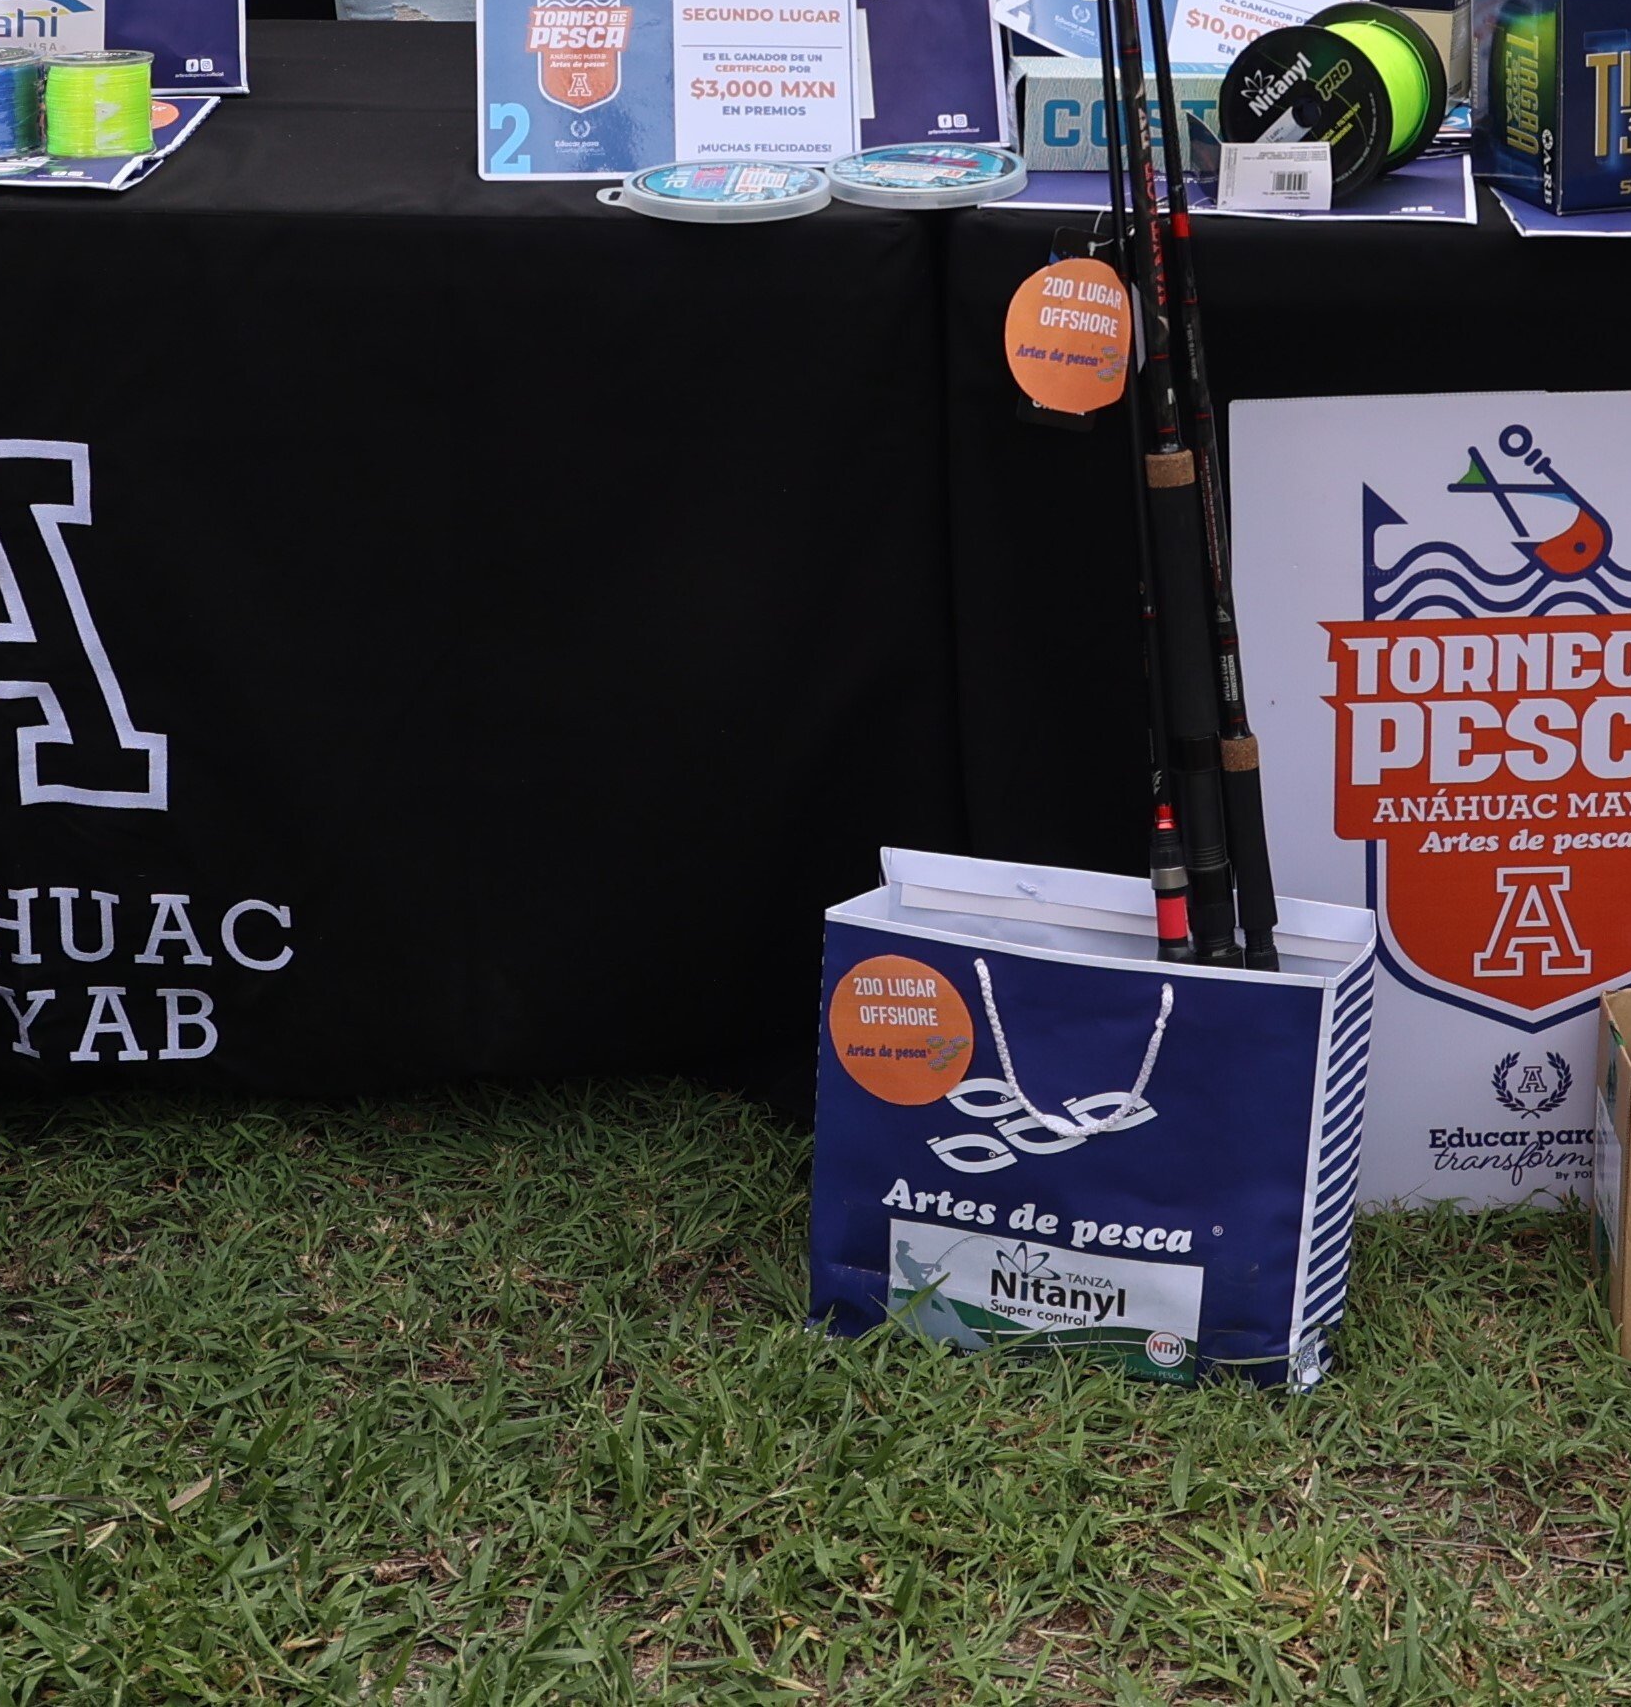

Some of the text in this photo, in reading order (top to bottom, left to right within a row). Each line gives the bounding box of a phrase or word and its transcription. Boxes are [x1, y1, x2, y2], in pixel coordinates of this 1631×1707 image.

[533, 11, 608, 26] TORNEO
[682, 8, 840, 23] SEGUNDO LUGAR
[1239, 0, 1293, 20] GANADOR
[530, 27, 626, 49] PESCA
[1217, 43, 1235, 55] EN
[703, 53, 716, 61] ES
[719, 53, 731, 61] EL
[734, 53, 787, 61] GANADOR
[808, 54, 822, 62] UN
[715, 65, 811, 73] CERTIFICADO POR
[1315, 59, 1352, 101] PRO
[690, 78, 835, 101] $3,000 MXN
[1248, 52, 1313, 117] Nitanyl
[722, 106, 806, 116] EN PREMIOS
[489, 102, 532, 173] 2
[698, 144, 832, 153] ¡MUCHAS FELICIDADES!
[1042, 276, 1073, 299] 2DO
[1040, 308, 1118, 338] OFFSHORE
[1372, 786, 1558, 825] ANÁHUAC
[1419, 828, 1502, 854] Artes
[1473, 865, 1592, 977] A
[852, 976, 937, 999] 2DO LUGAR
[859, 1005, 939, 1027] OFFSHORE
[1429, 1127, 1530, 1149] Educar
[881, 1178, 1193, 1254] Artes de pesca
[1066, 1273, 1113, 1290] TANZA
[991, 1269, 1126, 1322] Nitanyl
[990, 1299, 1086, 1327] Super control
[1152, 1341, 1179, 1355] NTH
